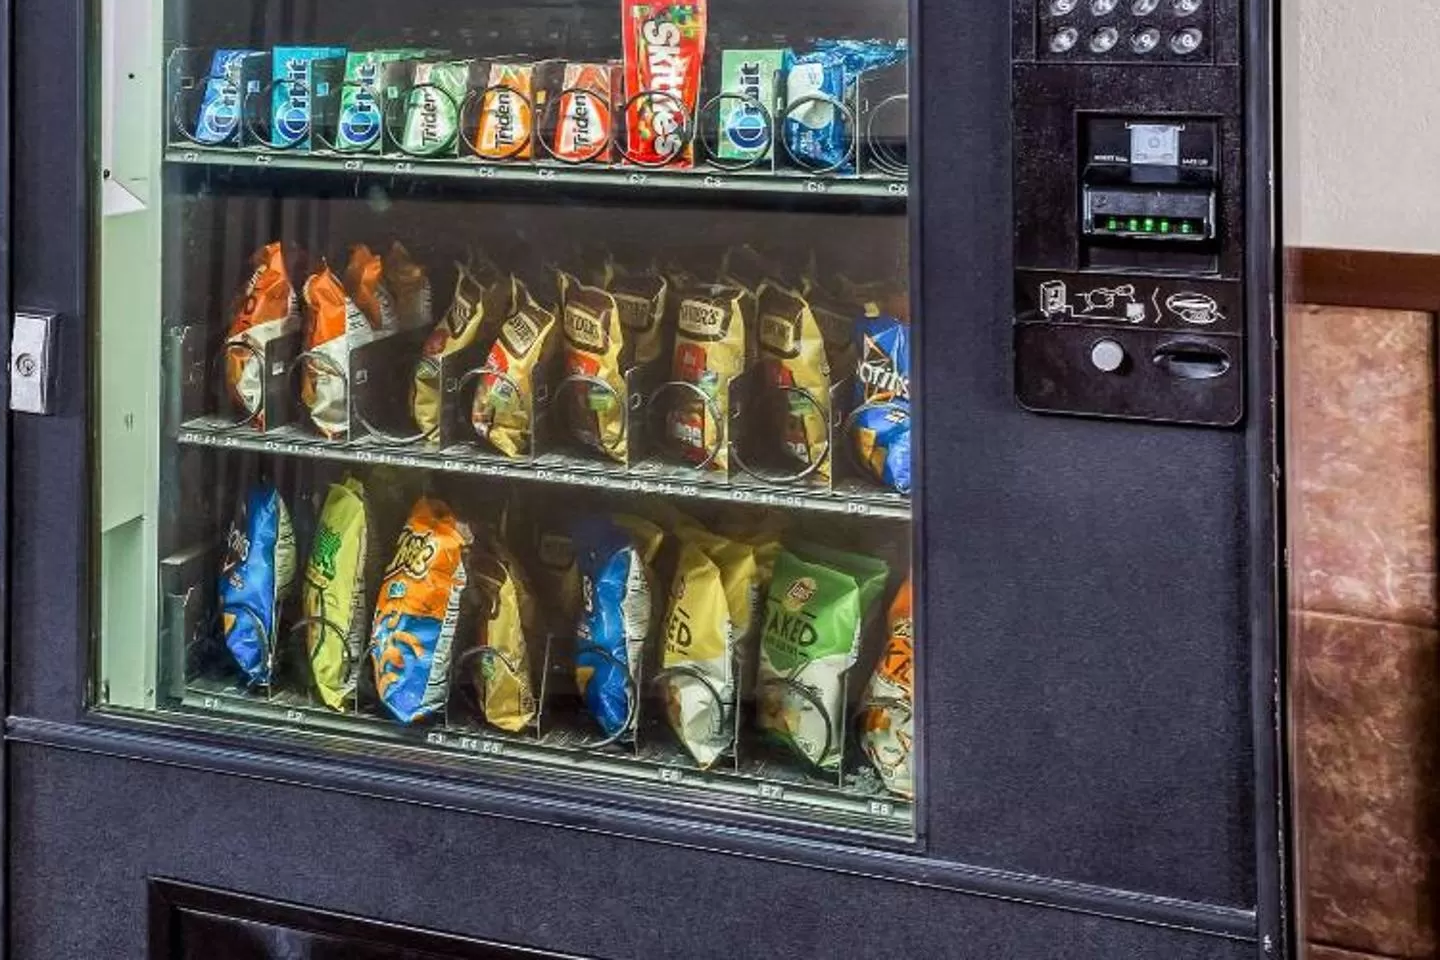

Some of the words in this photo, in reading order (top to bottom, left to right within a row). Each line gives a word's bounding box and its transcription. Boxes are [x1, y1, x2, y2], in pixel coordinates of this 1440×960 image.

[420, 88, 439, 148] Triden
[494, 87, 512, 150] Triden
[572, 90, 591, 152] Triden
[761, 784, 779, 798] E7
